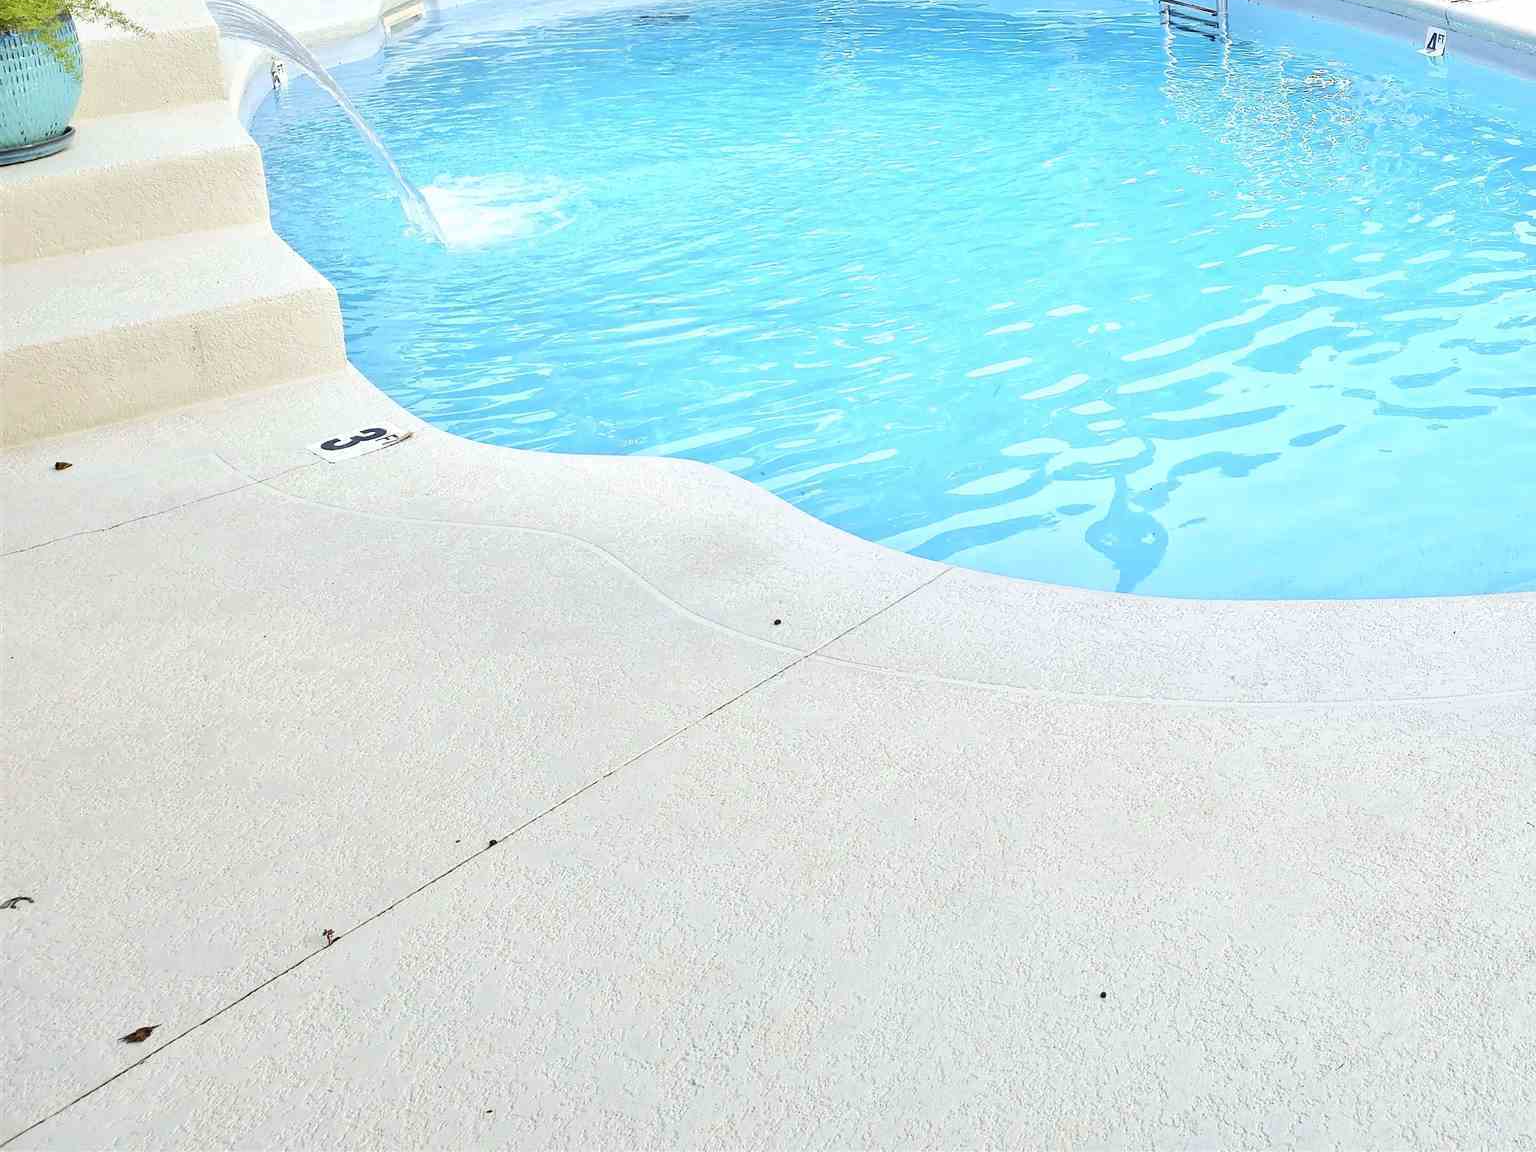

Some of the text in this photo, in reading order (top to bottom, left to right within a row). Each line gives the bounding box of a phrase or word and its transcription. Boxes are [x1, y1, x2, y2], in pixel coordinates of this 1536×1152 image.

[1426, 32, 1446, 51] 4 FT
[320, 427, 388, 451] 3
